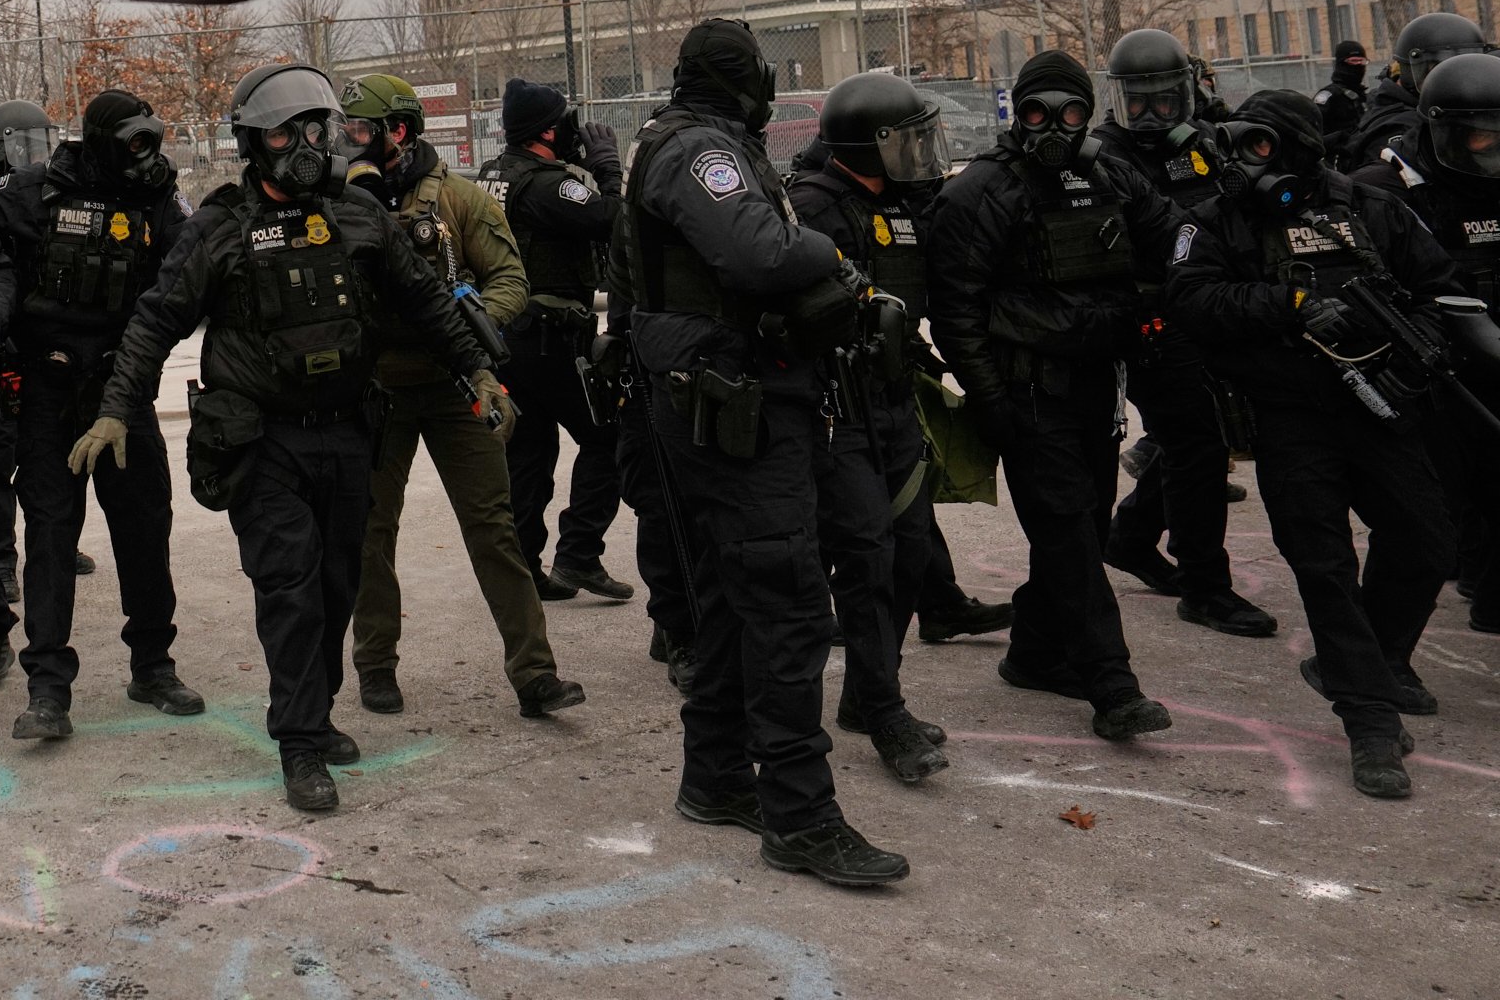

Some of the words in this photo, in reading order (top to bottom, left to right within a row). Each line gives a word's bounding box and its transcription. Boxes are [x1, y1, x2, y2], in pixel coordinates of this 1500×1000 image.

[708, 158, 735, 167] PROTECTION
[83, 201, 105, 210] M-333
[1071, 198, 1092, 207] M-380
[58, 208, 92, 225] POLICE
[277, 209, 302, 219] M-385
[890, 218, 915, 234] POLICE
[1463, 219, 1500, 234] POLICE
[251, 225, 284, 243] POLICE
[1306, 238, 1334, 246] CUSTOM
[1293, 246, 1318, 254] BORDER
